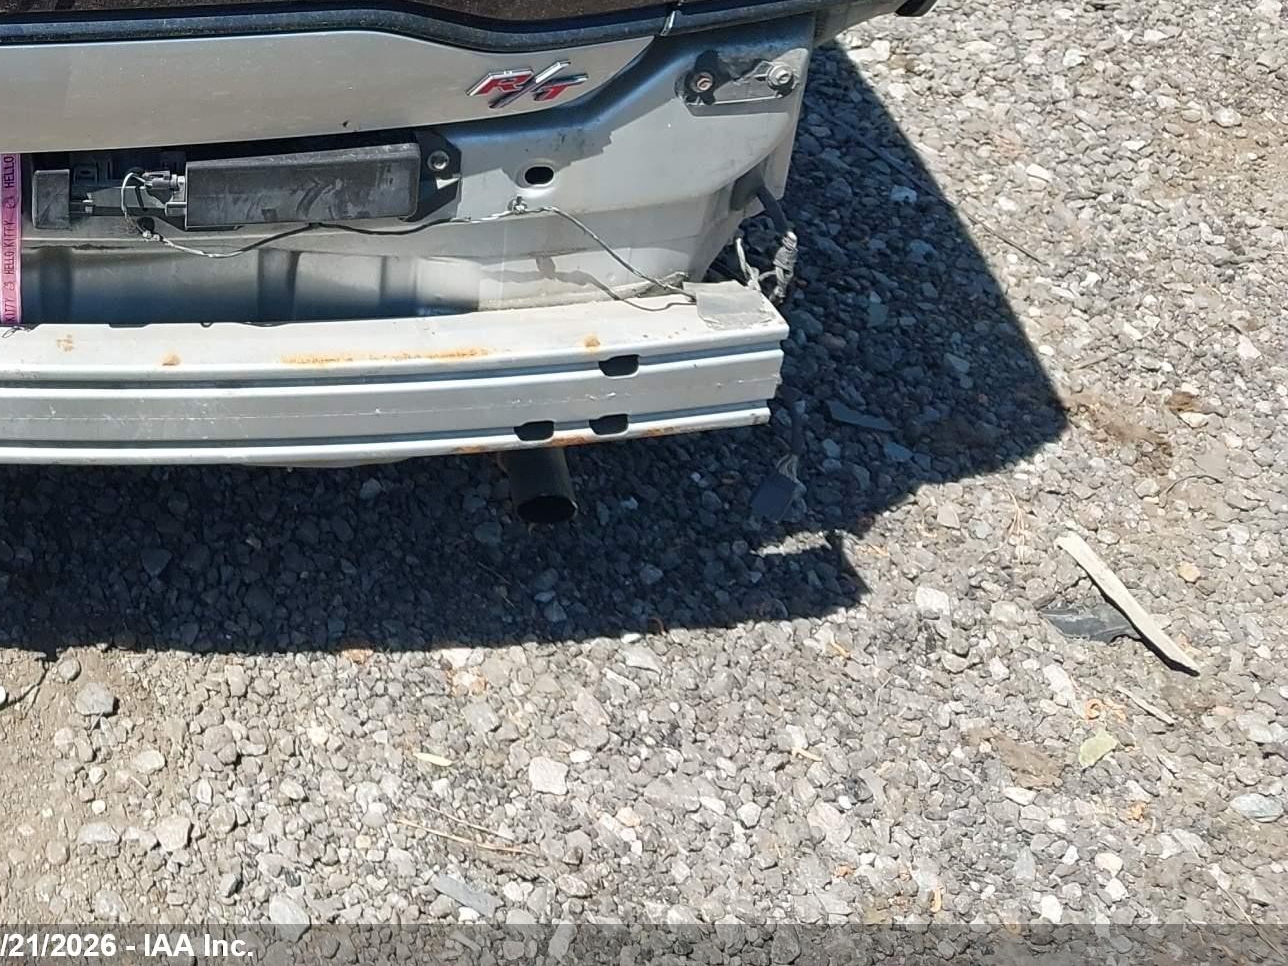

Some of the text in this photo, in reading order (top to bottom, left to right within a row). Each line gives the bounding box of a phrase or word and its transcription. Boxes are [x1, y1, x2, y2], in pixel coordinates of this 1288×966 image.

[466, 59, 589, 109] R/T
[3, 156, 15, 189] HELLO
[4, 220, 16, 247] KITTY
[4, 251, 15, 275] HELLO
